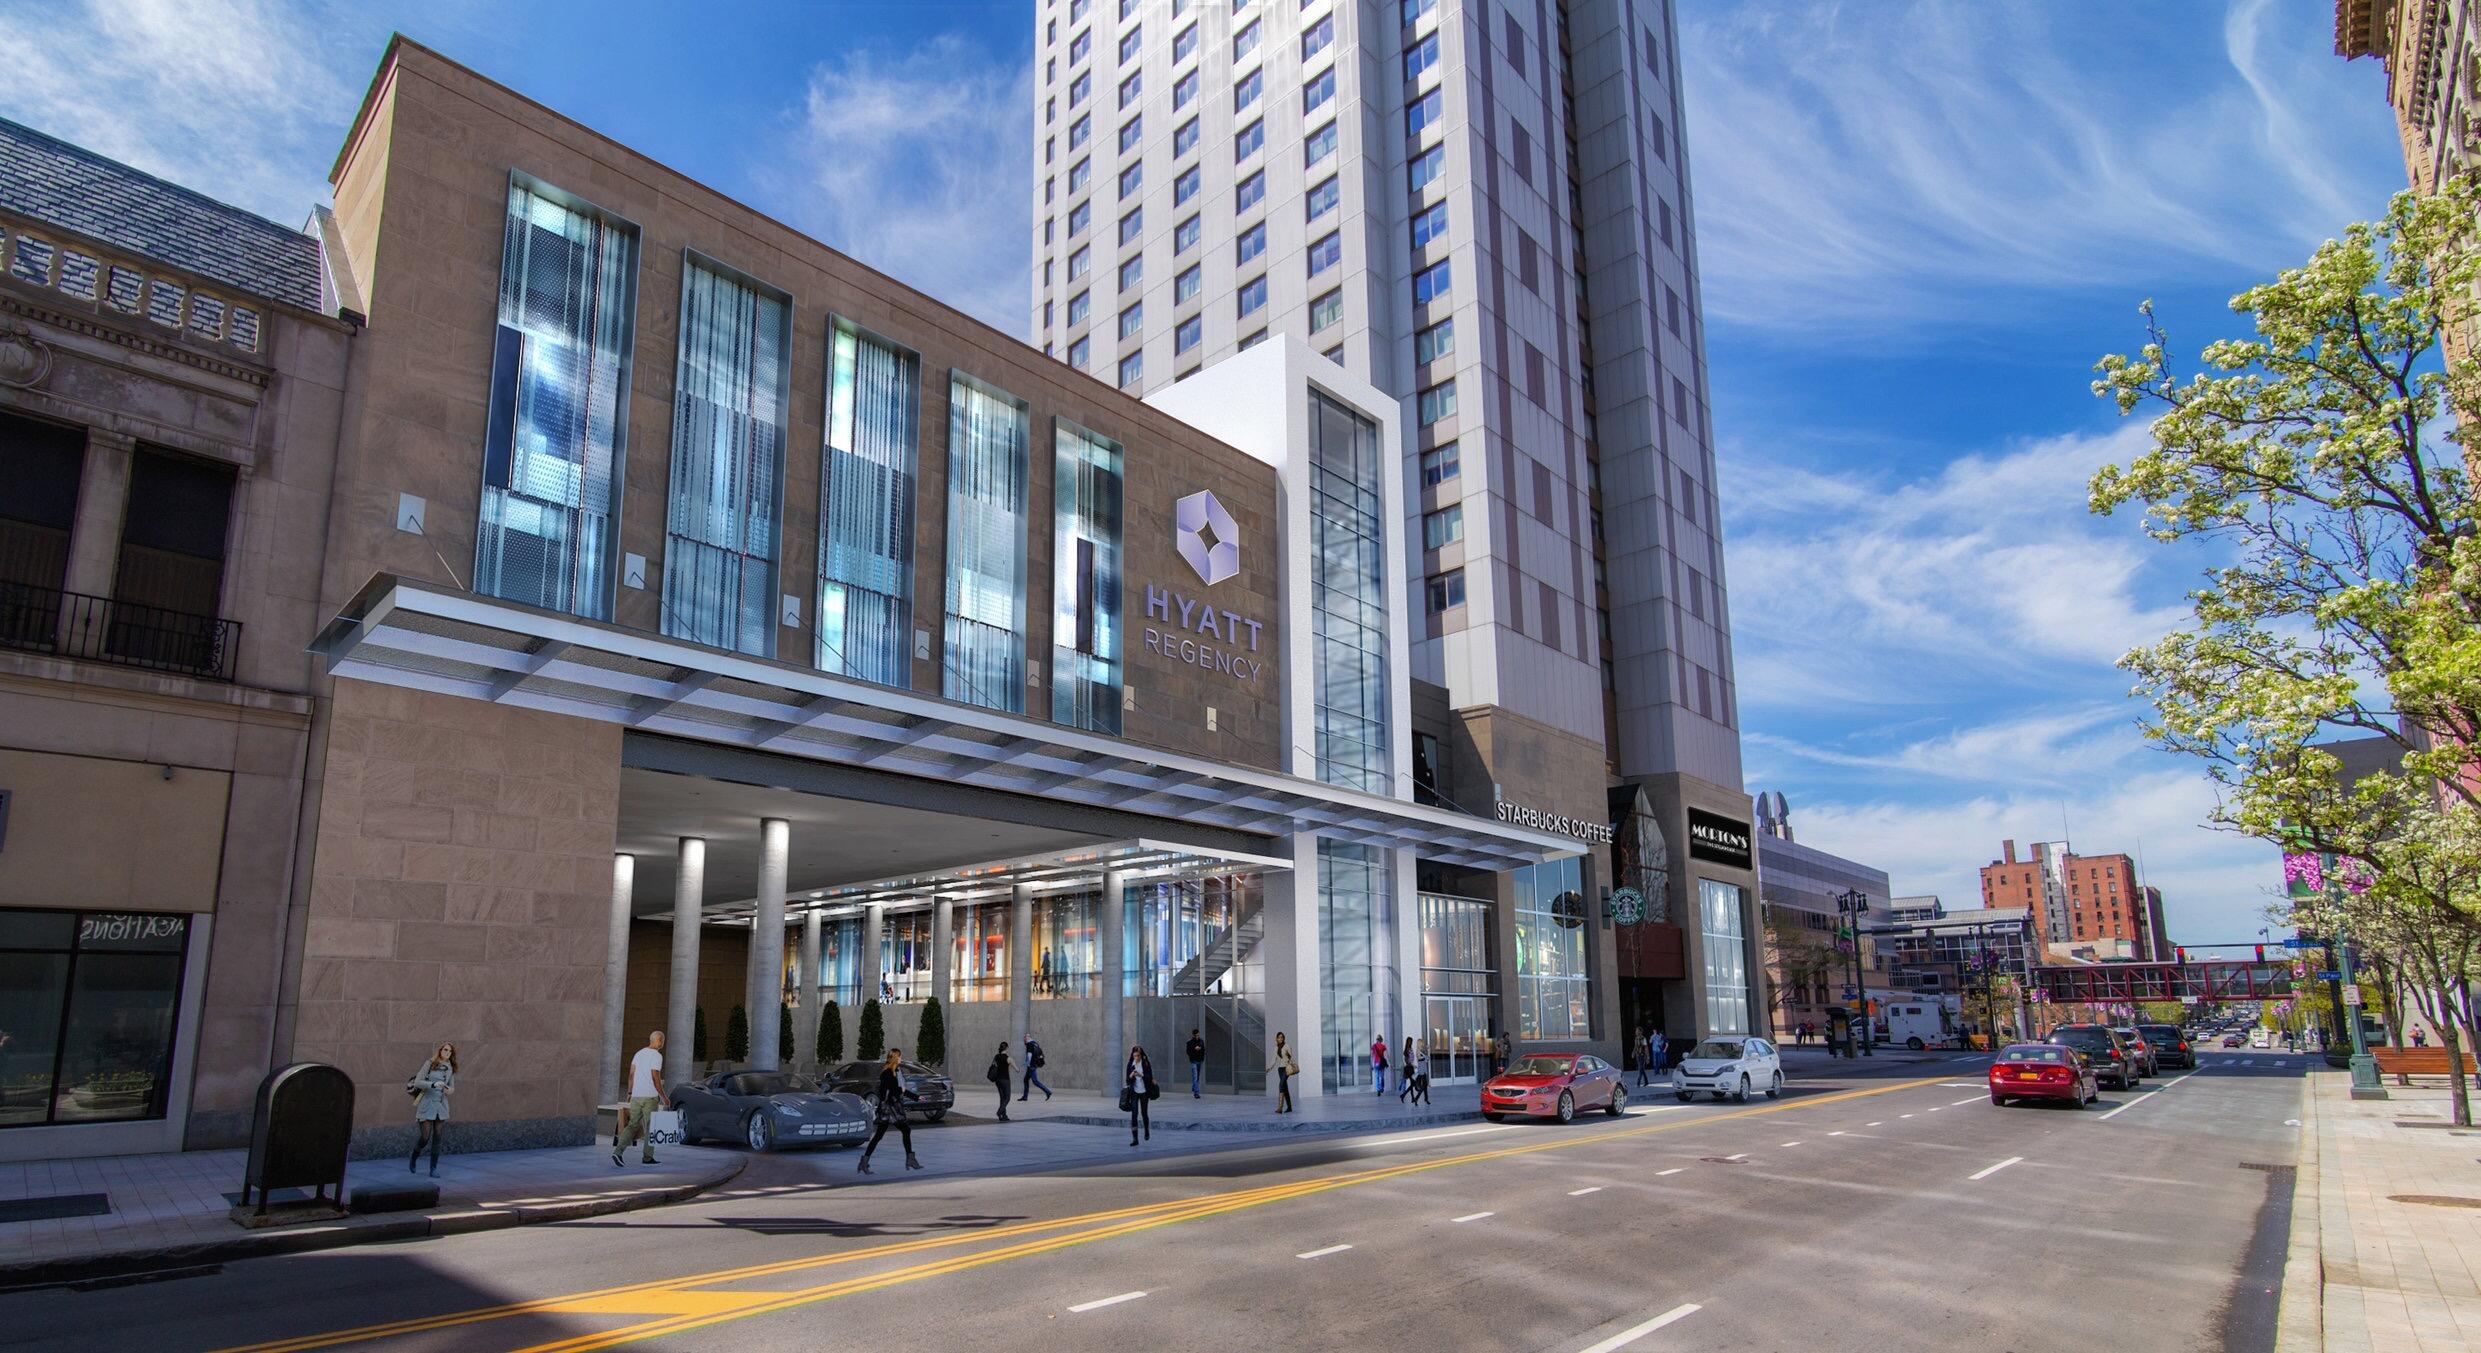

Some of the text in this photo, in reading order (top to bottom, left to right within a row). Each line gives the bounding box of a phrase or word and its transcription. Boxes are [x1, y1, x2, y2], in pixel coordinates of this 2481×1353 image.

[1146, 584, 1263, 652] HYATT
[1144, 627, 1262, 683] REGENCY
[1497, 801, 1613, 844] STARBUCKS COFFEE
[1691, 824, 1748, 849] MORTON'S
[1610, 888, 1643, 905] STARBUCKS
[1614, 913, 1641, 924] COFFEE
